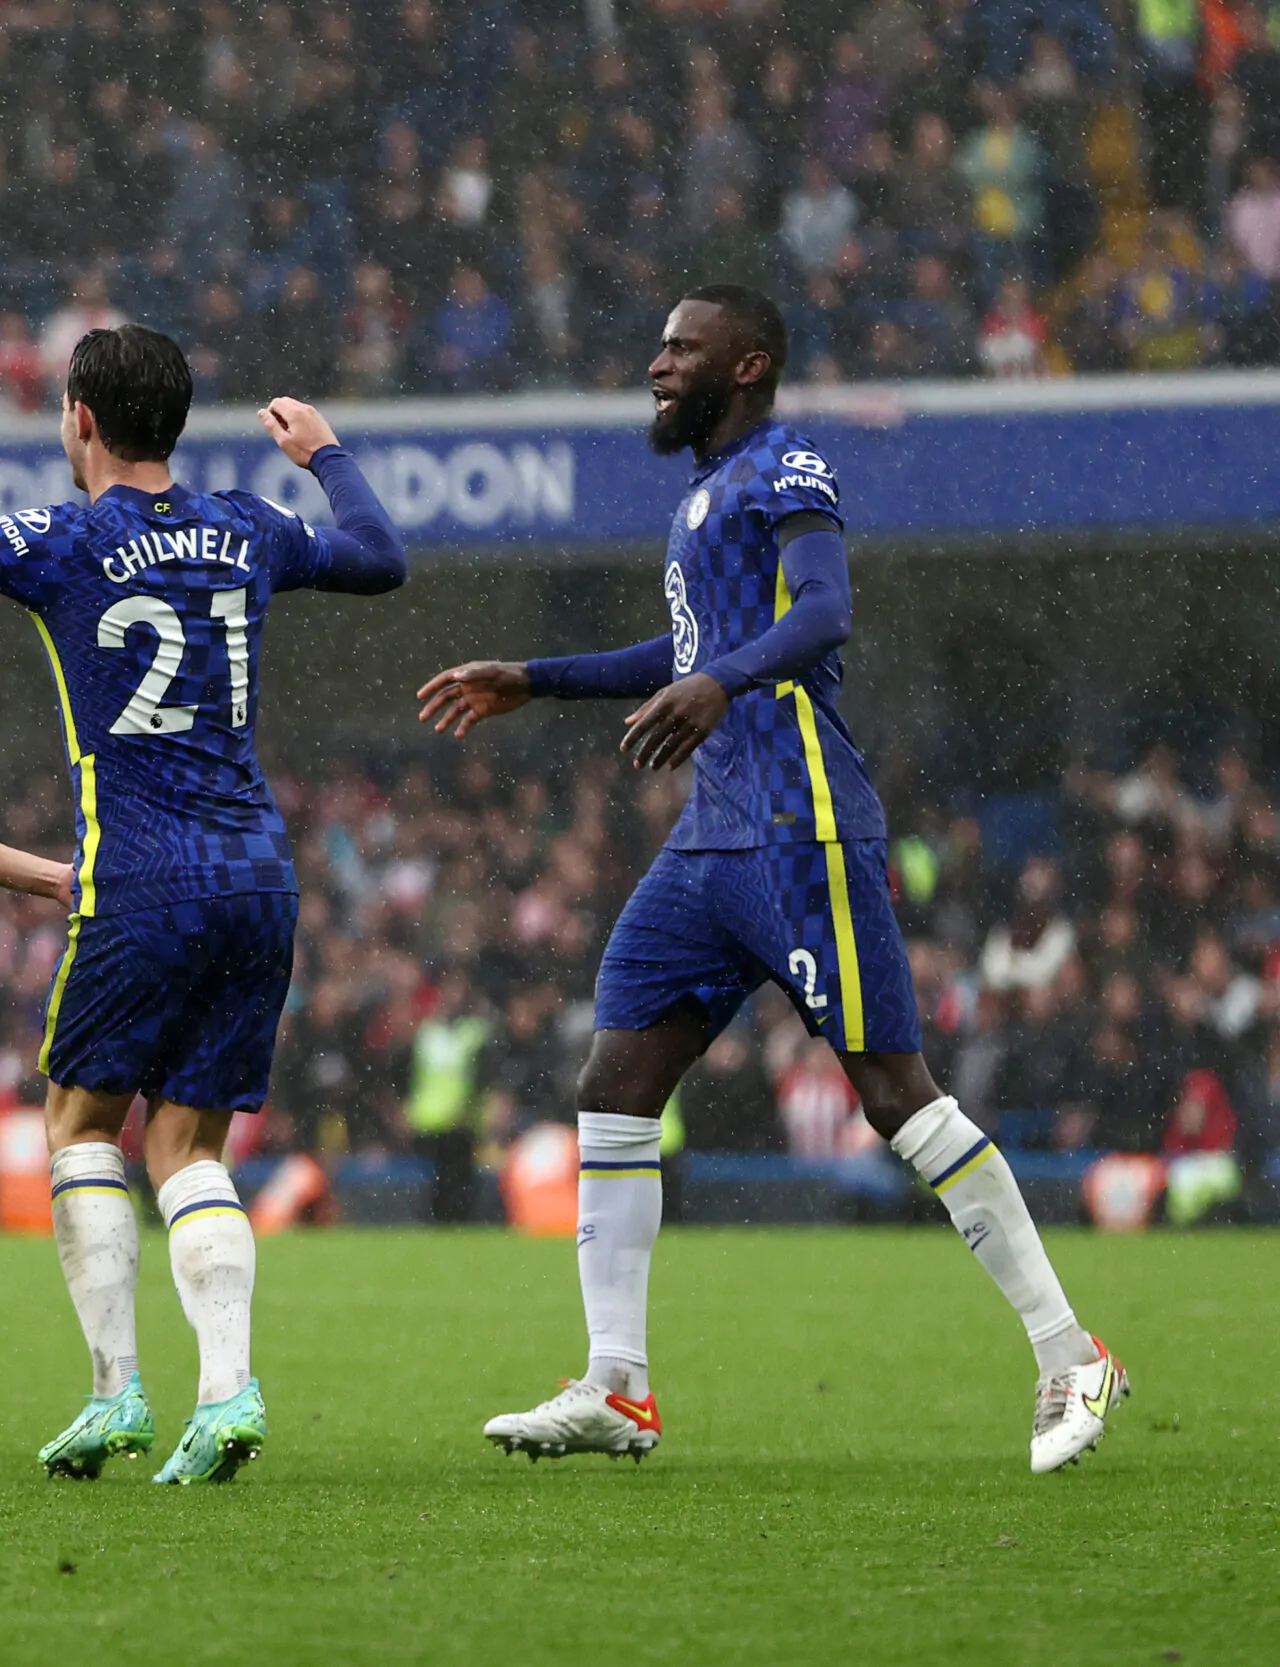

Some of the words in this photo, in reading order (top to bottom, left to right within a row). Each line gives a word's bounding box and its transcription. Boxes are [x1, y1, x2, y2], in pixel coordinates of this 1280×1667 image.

[773, 475, 838, 505] HYUND
[103, 528, 250, 583] CHILWELL
[97, 587, 249, 734] 21
[788, 948, 828, 1009] 2
